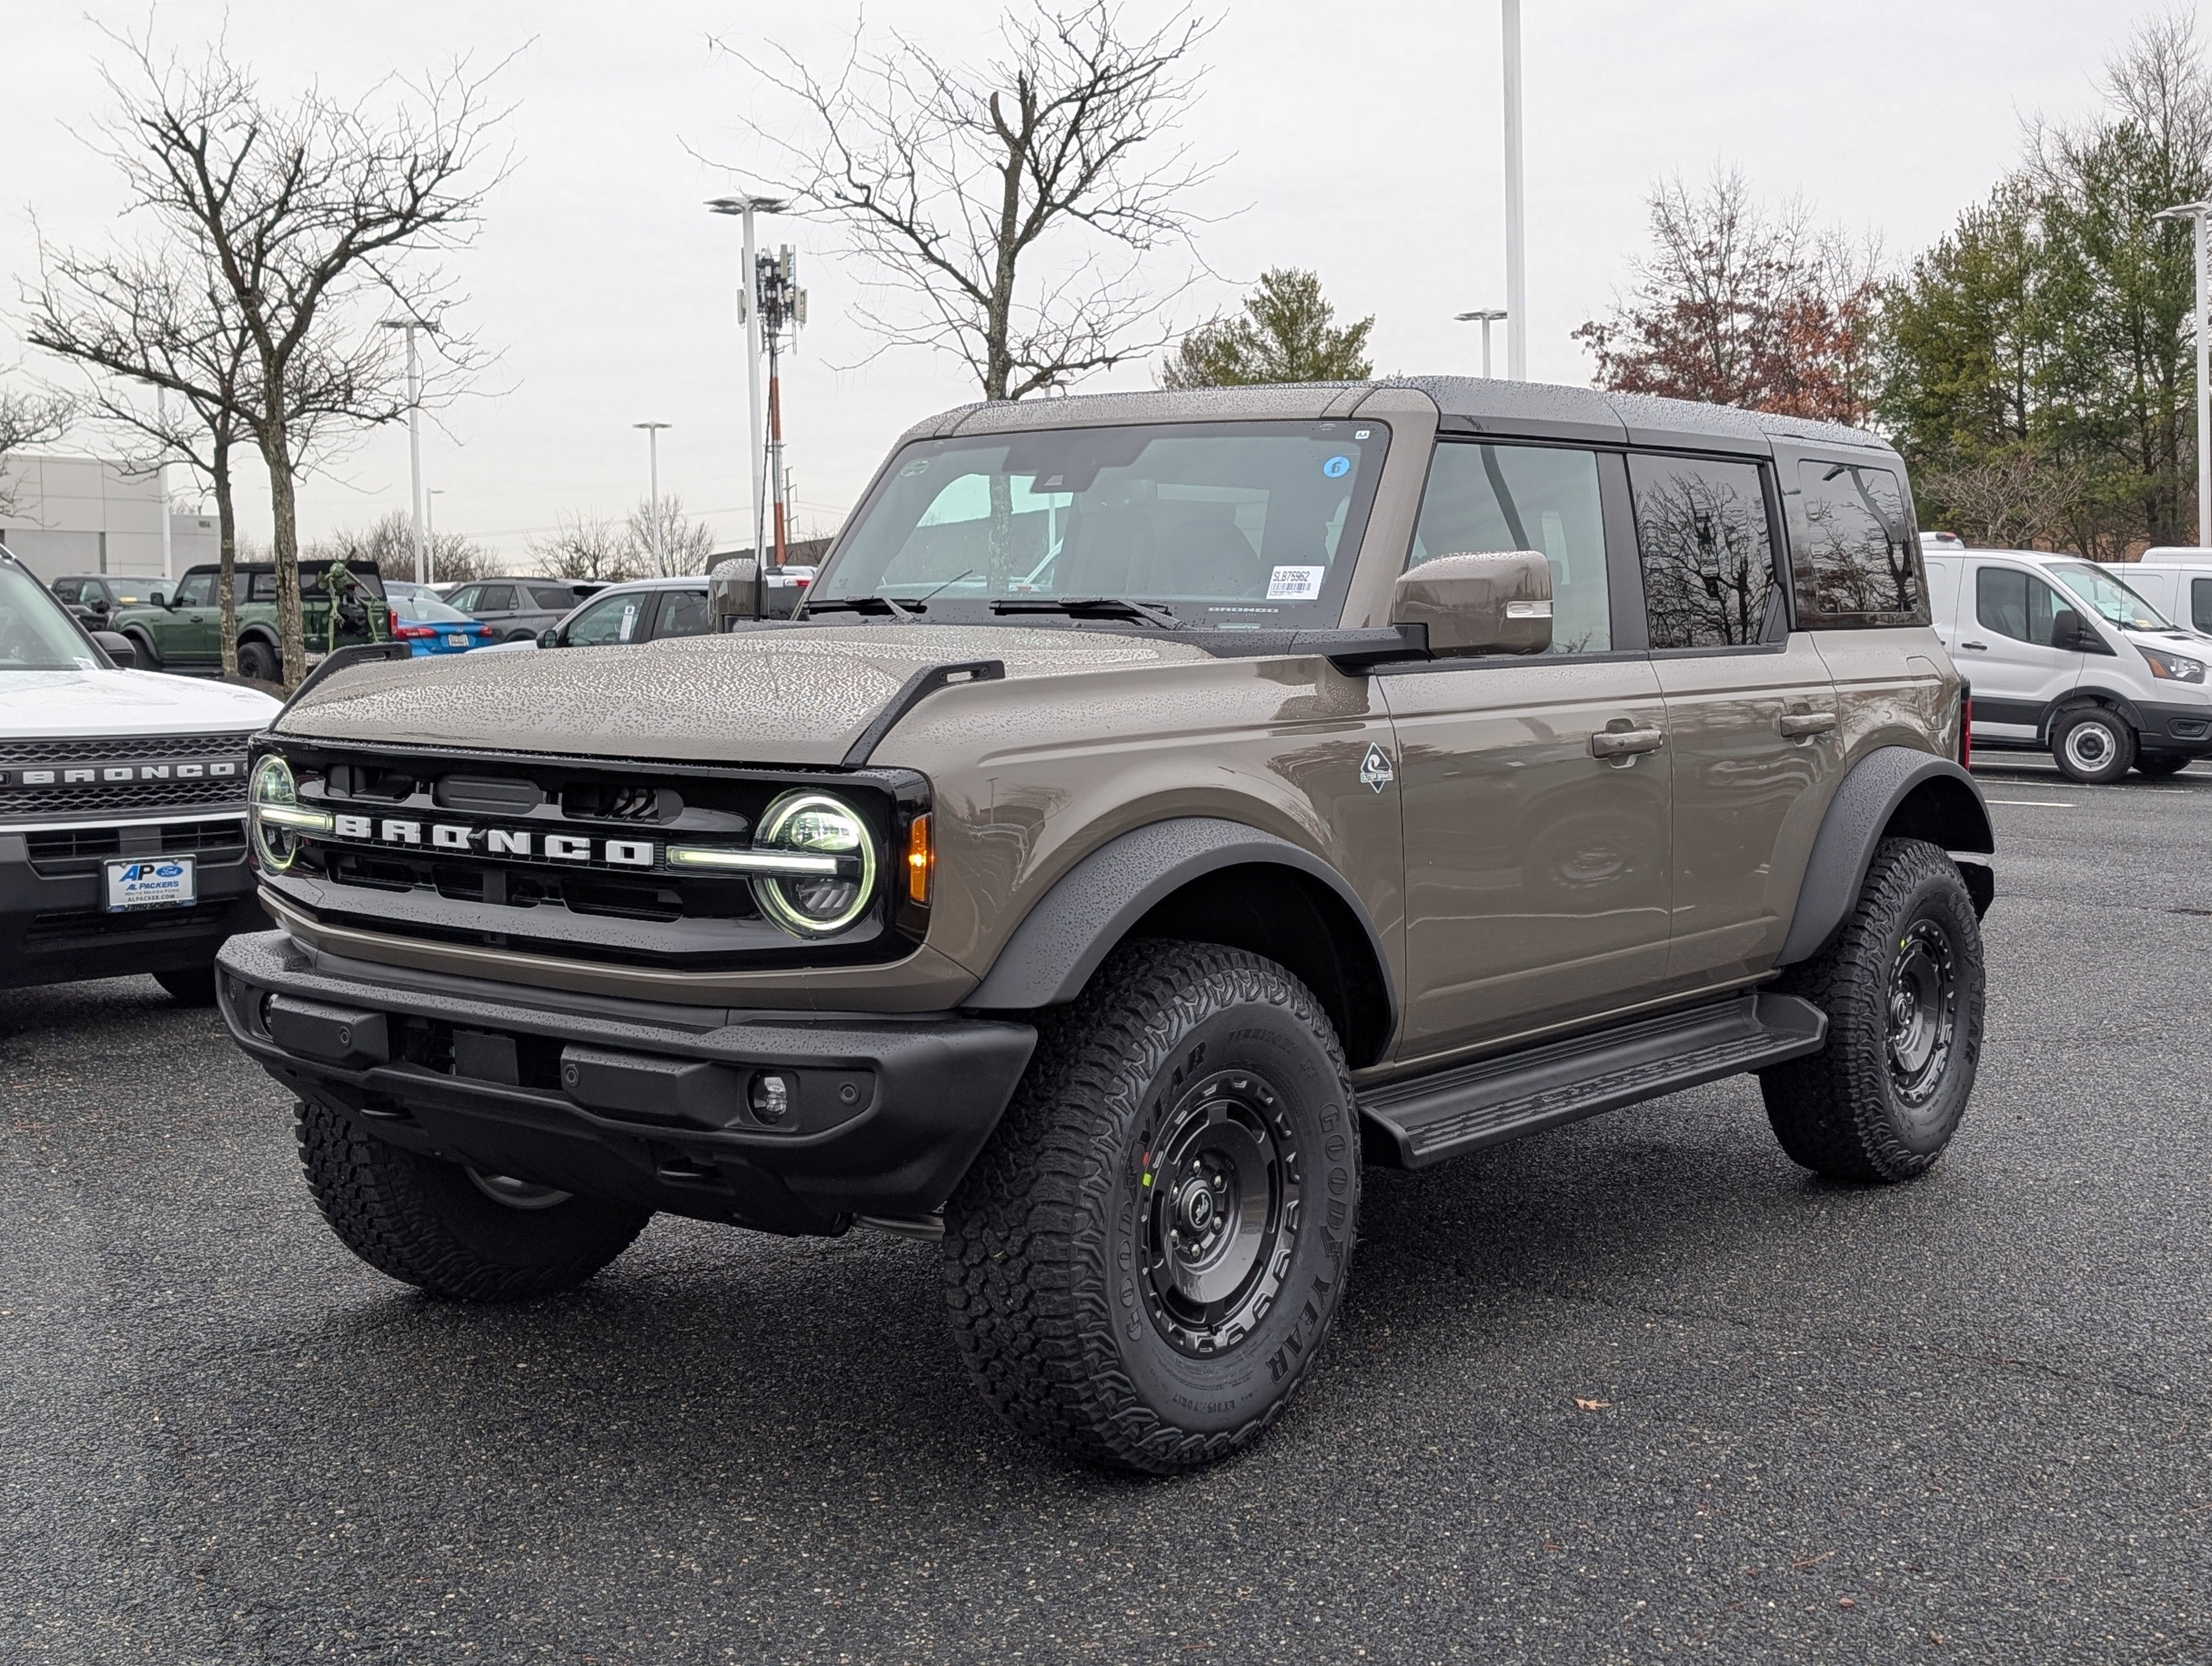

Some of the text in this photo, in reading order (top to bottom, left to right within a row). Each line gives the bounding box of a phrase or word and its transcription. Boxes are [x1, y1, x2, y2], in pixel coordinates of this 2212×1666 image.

[1272, 571, 1310, 582] SLB75962
[22, 762, 235, 784] BRONCO
[335, 814, 654, 866] BRONCO
[118, 864, 155, 882] AP
[127, 894, 176, 902] ALPACKER.COM
